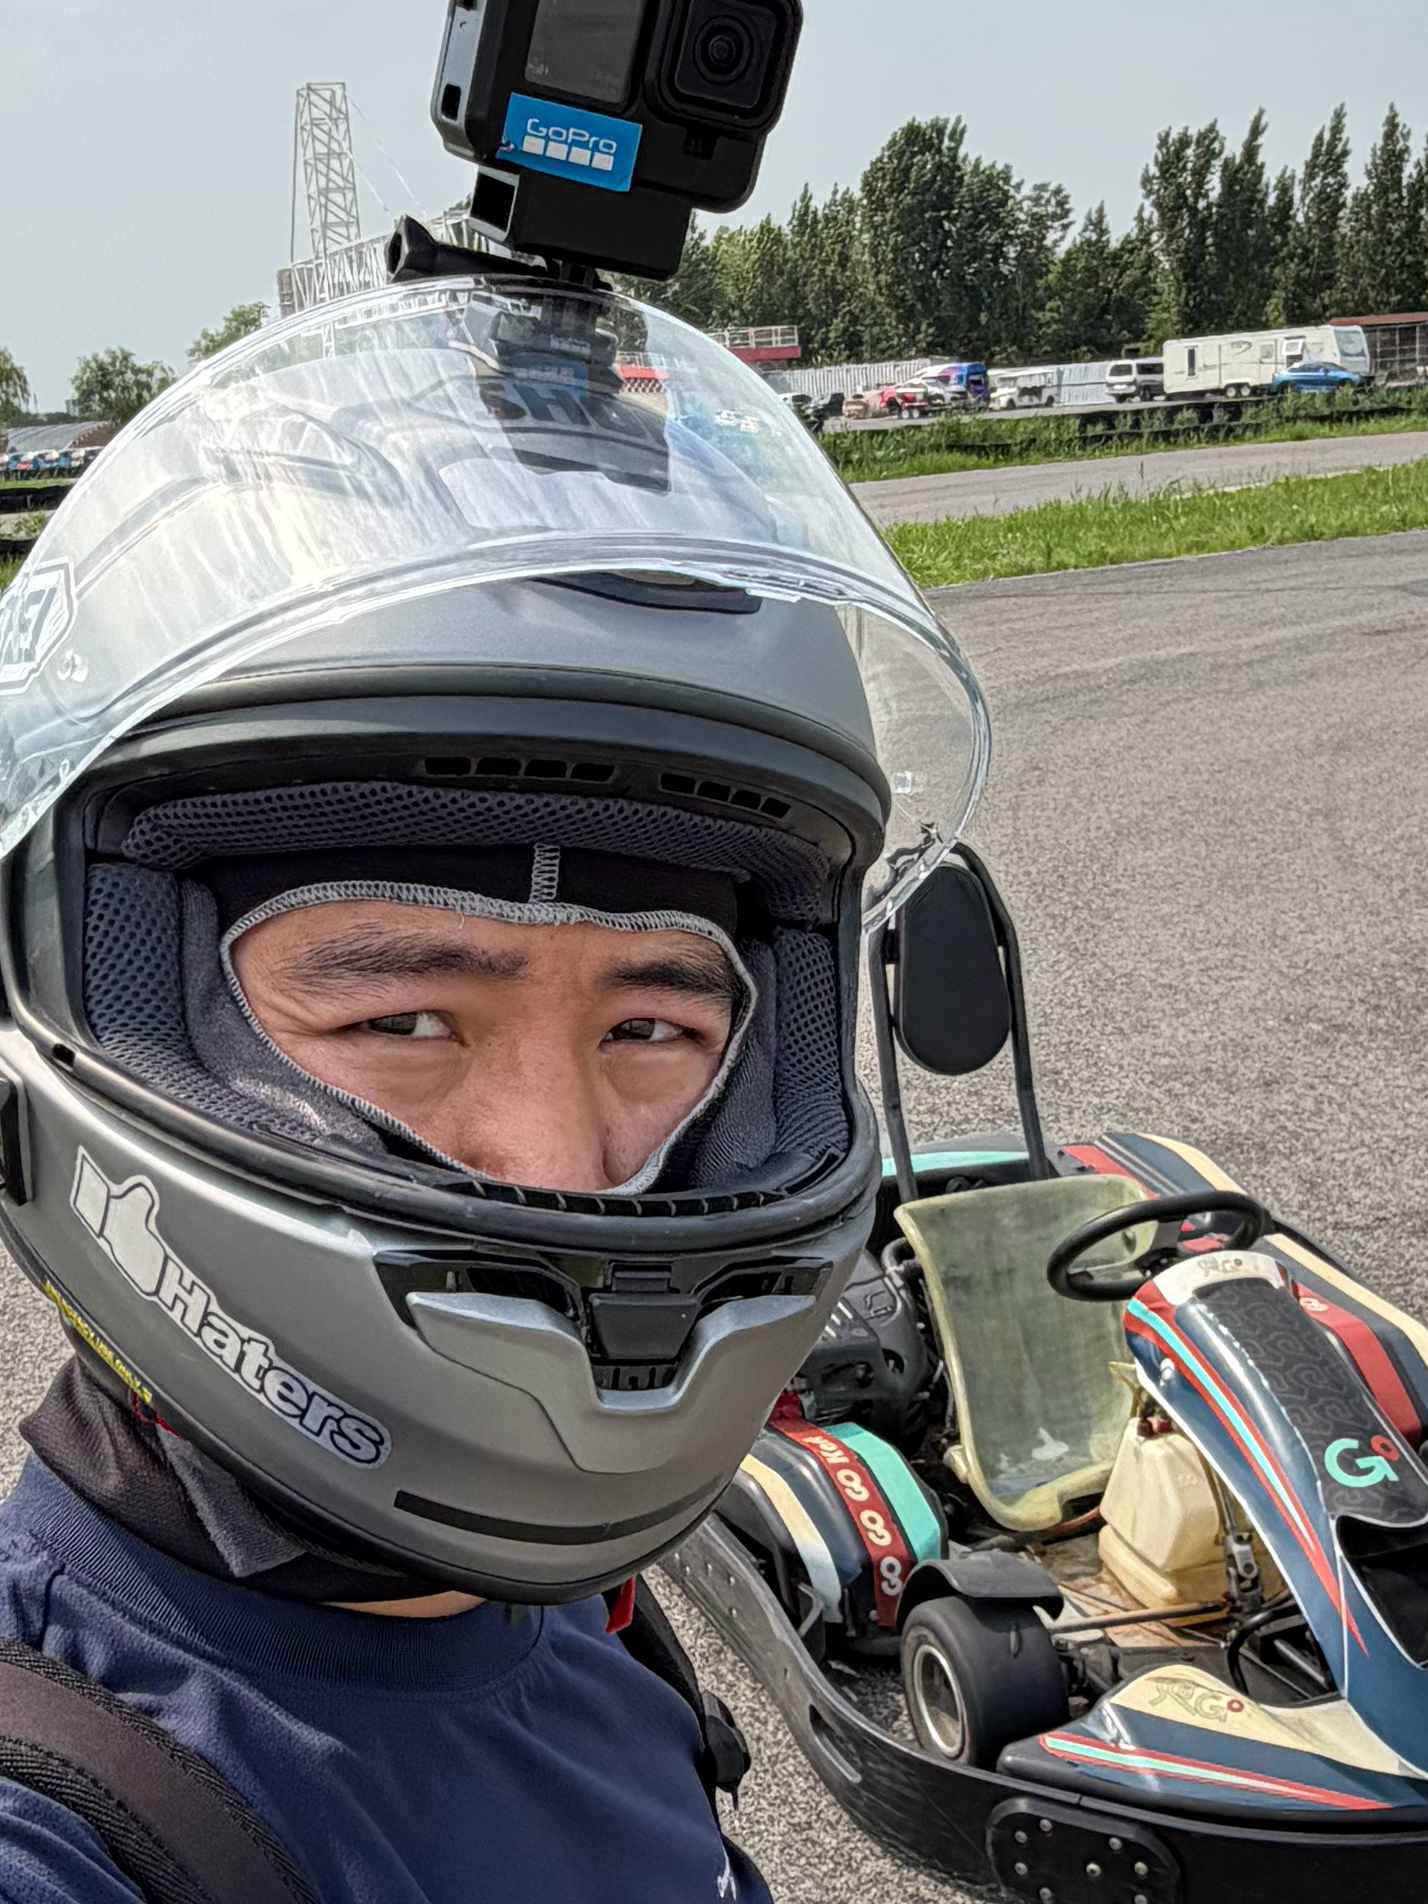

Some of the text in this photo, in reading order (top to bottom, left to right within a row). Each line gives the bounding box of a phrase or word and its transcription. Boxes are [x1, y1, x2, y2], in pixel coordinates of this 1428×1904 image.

[526, 117, 617, 154] GoPro
[158, 1256, 385, 1465] Haters
[836, 1468, 870, 1502] GO
[859, 1509, 892, 1546] GO
